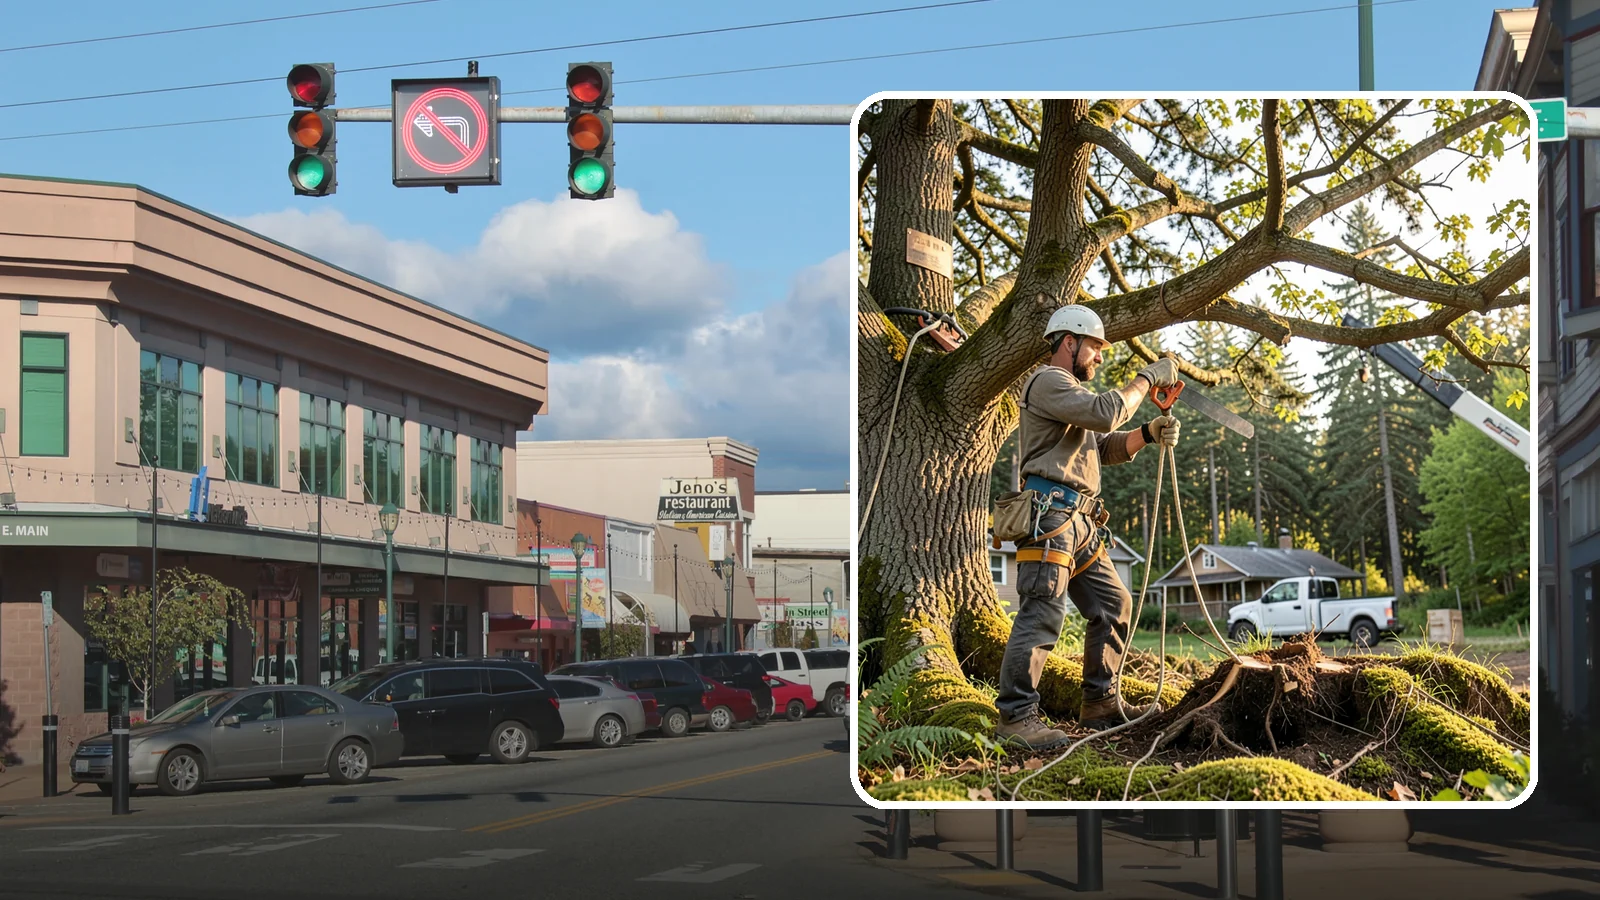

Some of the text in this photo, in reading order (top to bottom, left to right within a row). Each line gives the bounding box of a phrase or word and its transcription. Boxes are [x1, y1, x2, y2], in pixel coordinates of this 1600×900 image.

[669, 480, 727, 494] Jeno's
[664, 496, 731, 509] restaurant
[659, 510, 682, 520] Italian
[686, 510, 715, 519] American
[715, 509, 738, 519] Cuisine
[2, 525, 49, 536] E. MAIN
[797, 607, 828, 617] Street
[791, 619, 823, 628] lass
